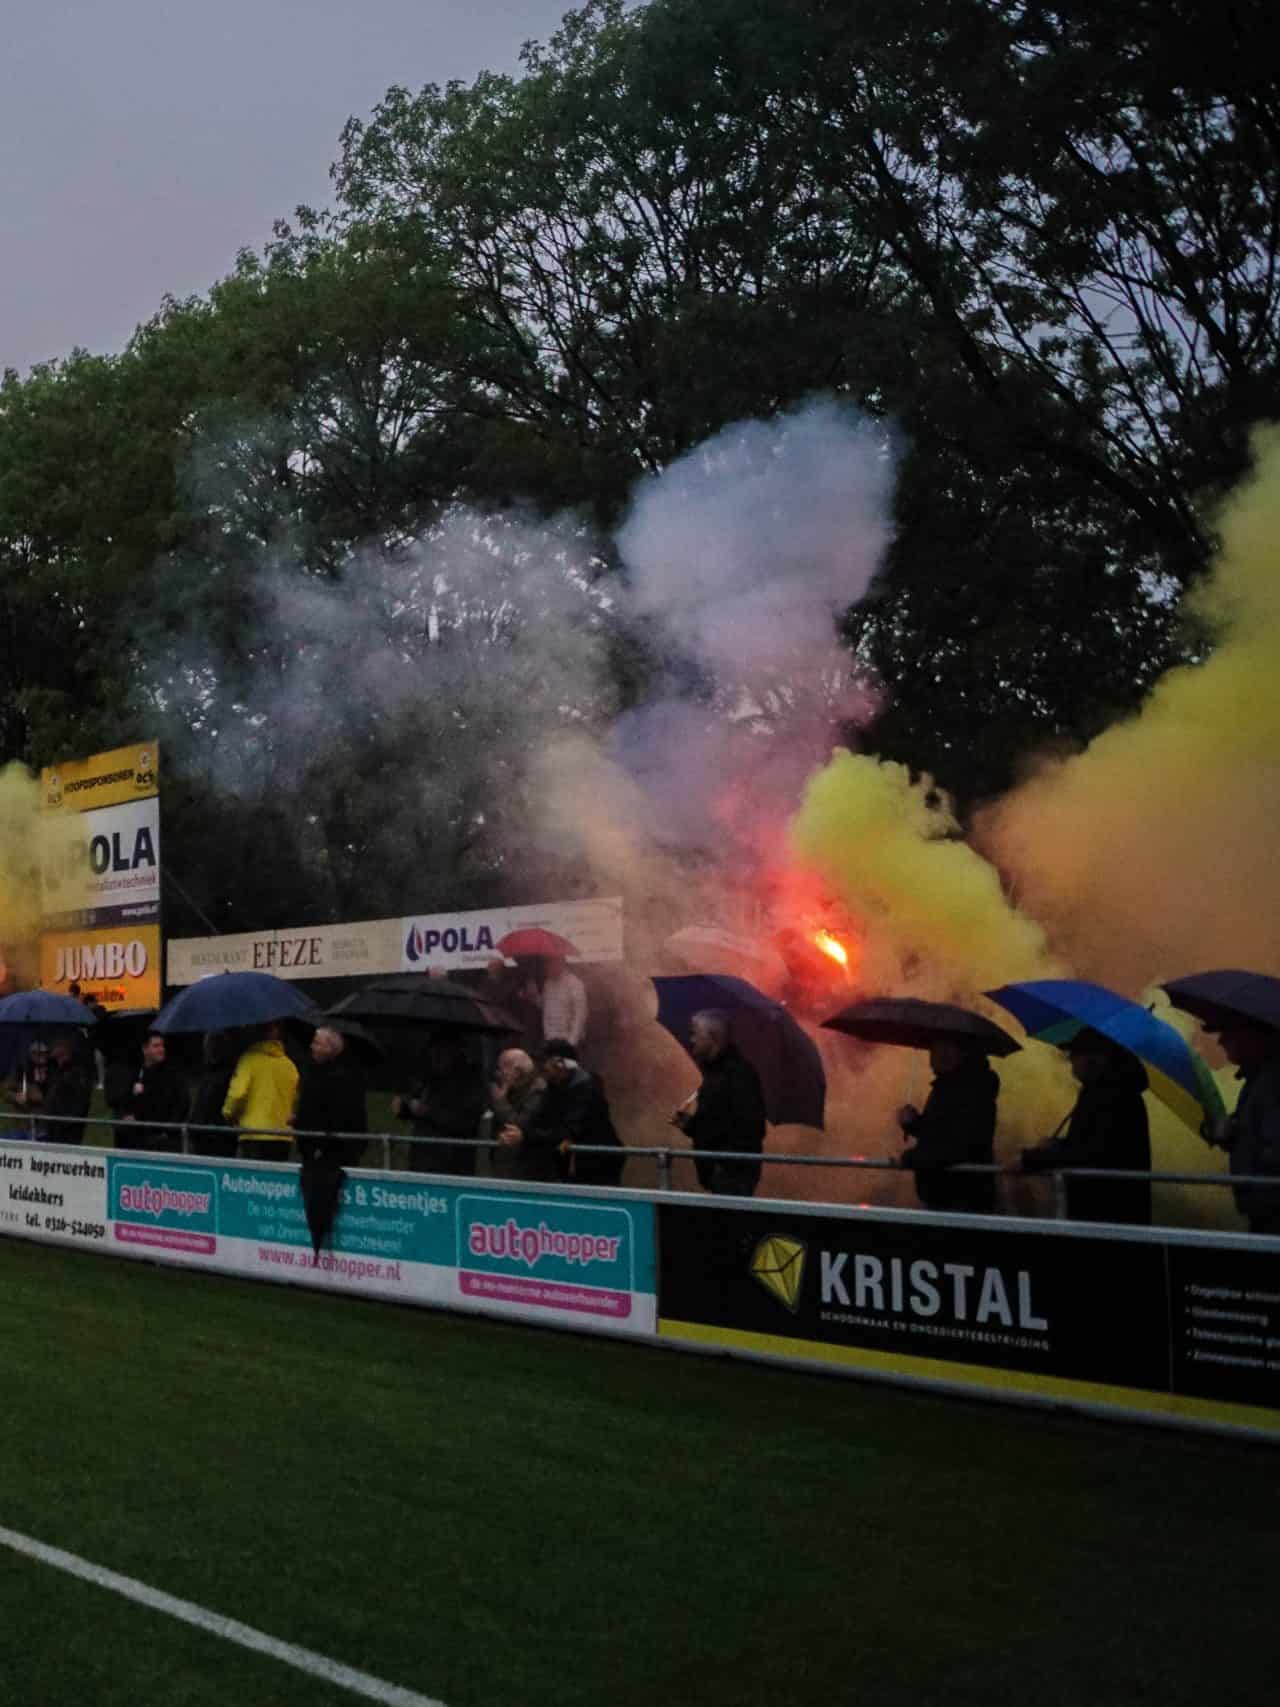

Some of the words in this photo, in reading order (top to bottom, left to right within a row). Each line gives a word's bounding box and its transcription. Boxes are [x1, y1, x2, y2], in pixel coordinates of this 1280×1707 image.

[252, 937, 324, 968] EFEZE
[425, 925, 494, 954] POLA
[54, 938, 148, 982] JUMBO
[120, 1181, 211, 1219] autohopper
[221, 1173, 297, 1199] Autohopper
[372, 1187, 449, 1216] Steentjes
[25, 1213, 41, 1227] tel.
[469, 1218, 621, 1267] autohopper
[820, 1250, 1049, 1332] KRISTAL
[820, 1311, 890, 1329] SCHOONMAAK
